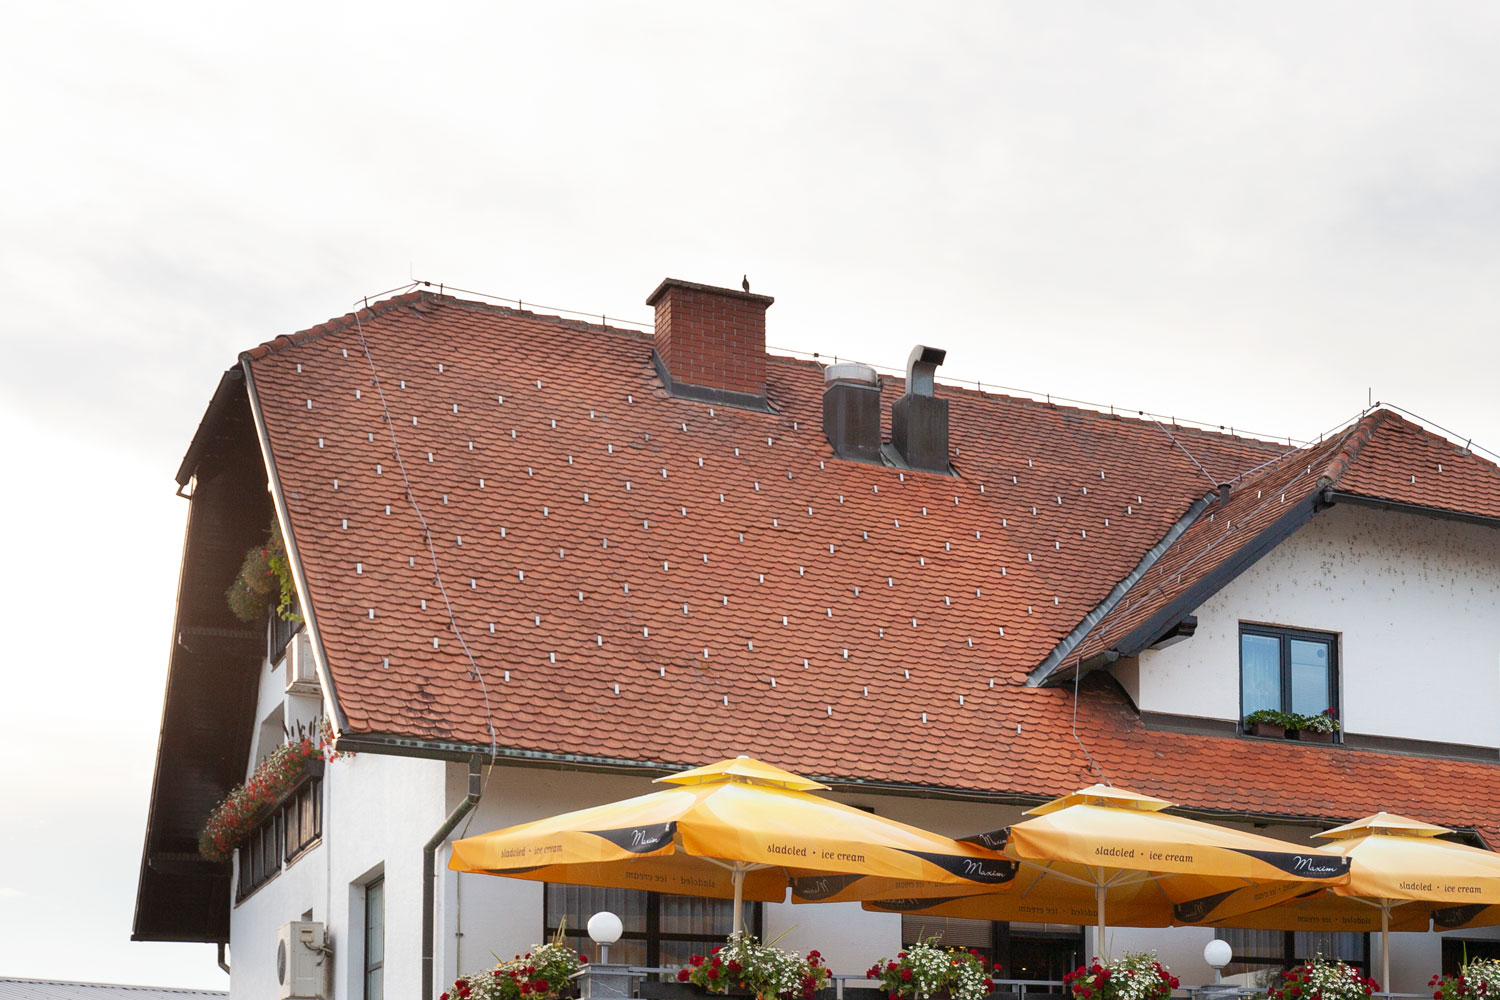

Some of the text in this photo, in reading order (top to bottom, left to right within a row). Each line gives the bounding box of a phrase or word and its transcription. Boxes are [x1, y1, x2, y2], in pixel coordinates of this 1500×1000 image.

[501, 844, 563, 858] sladoled ice cream
[767, 843, 865, 863] sladoled ice cream
[1095, 846, 1194, 863] sladoled ice cream
[963, 859, 1007, 877] Maxim
[1293, 855, 1338, 872] Maxim
[1399, 881, 1482, 894] sladoled ice cream
